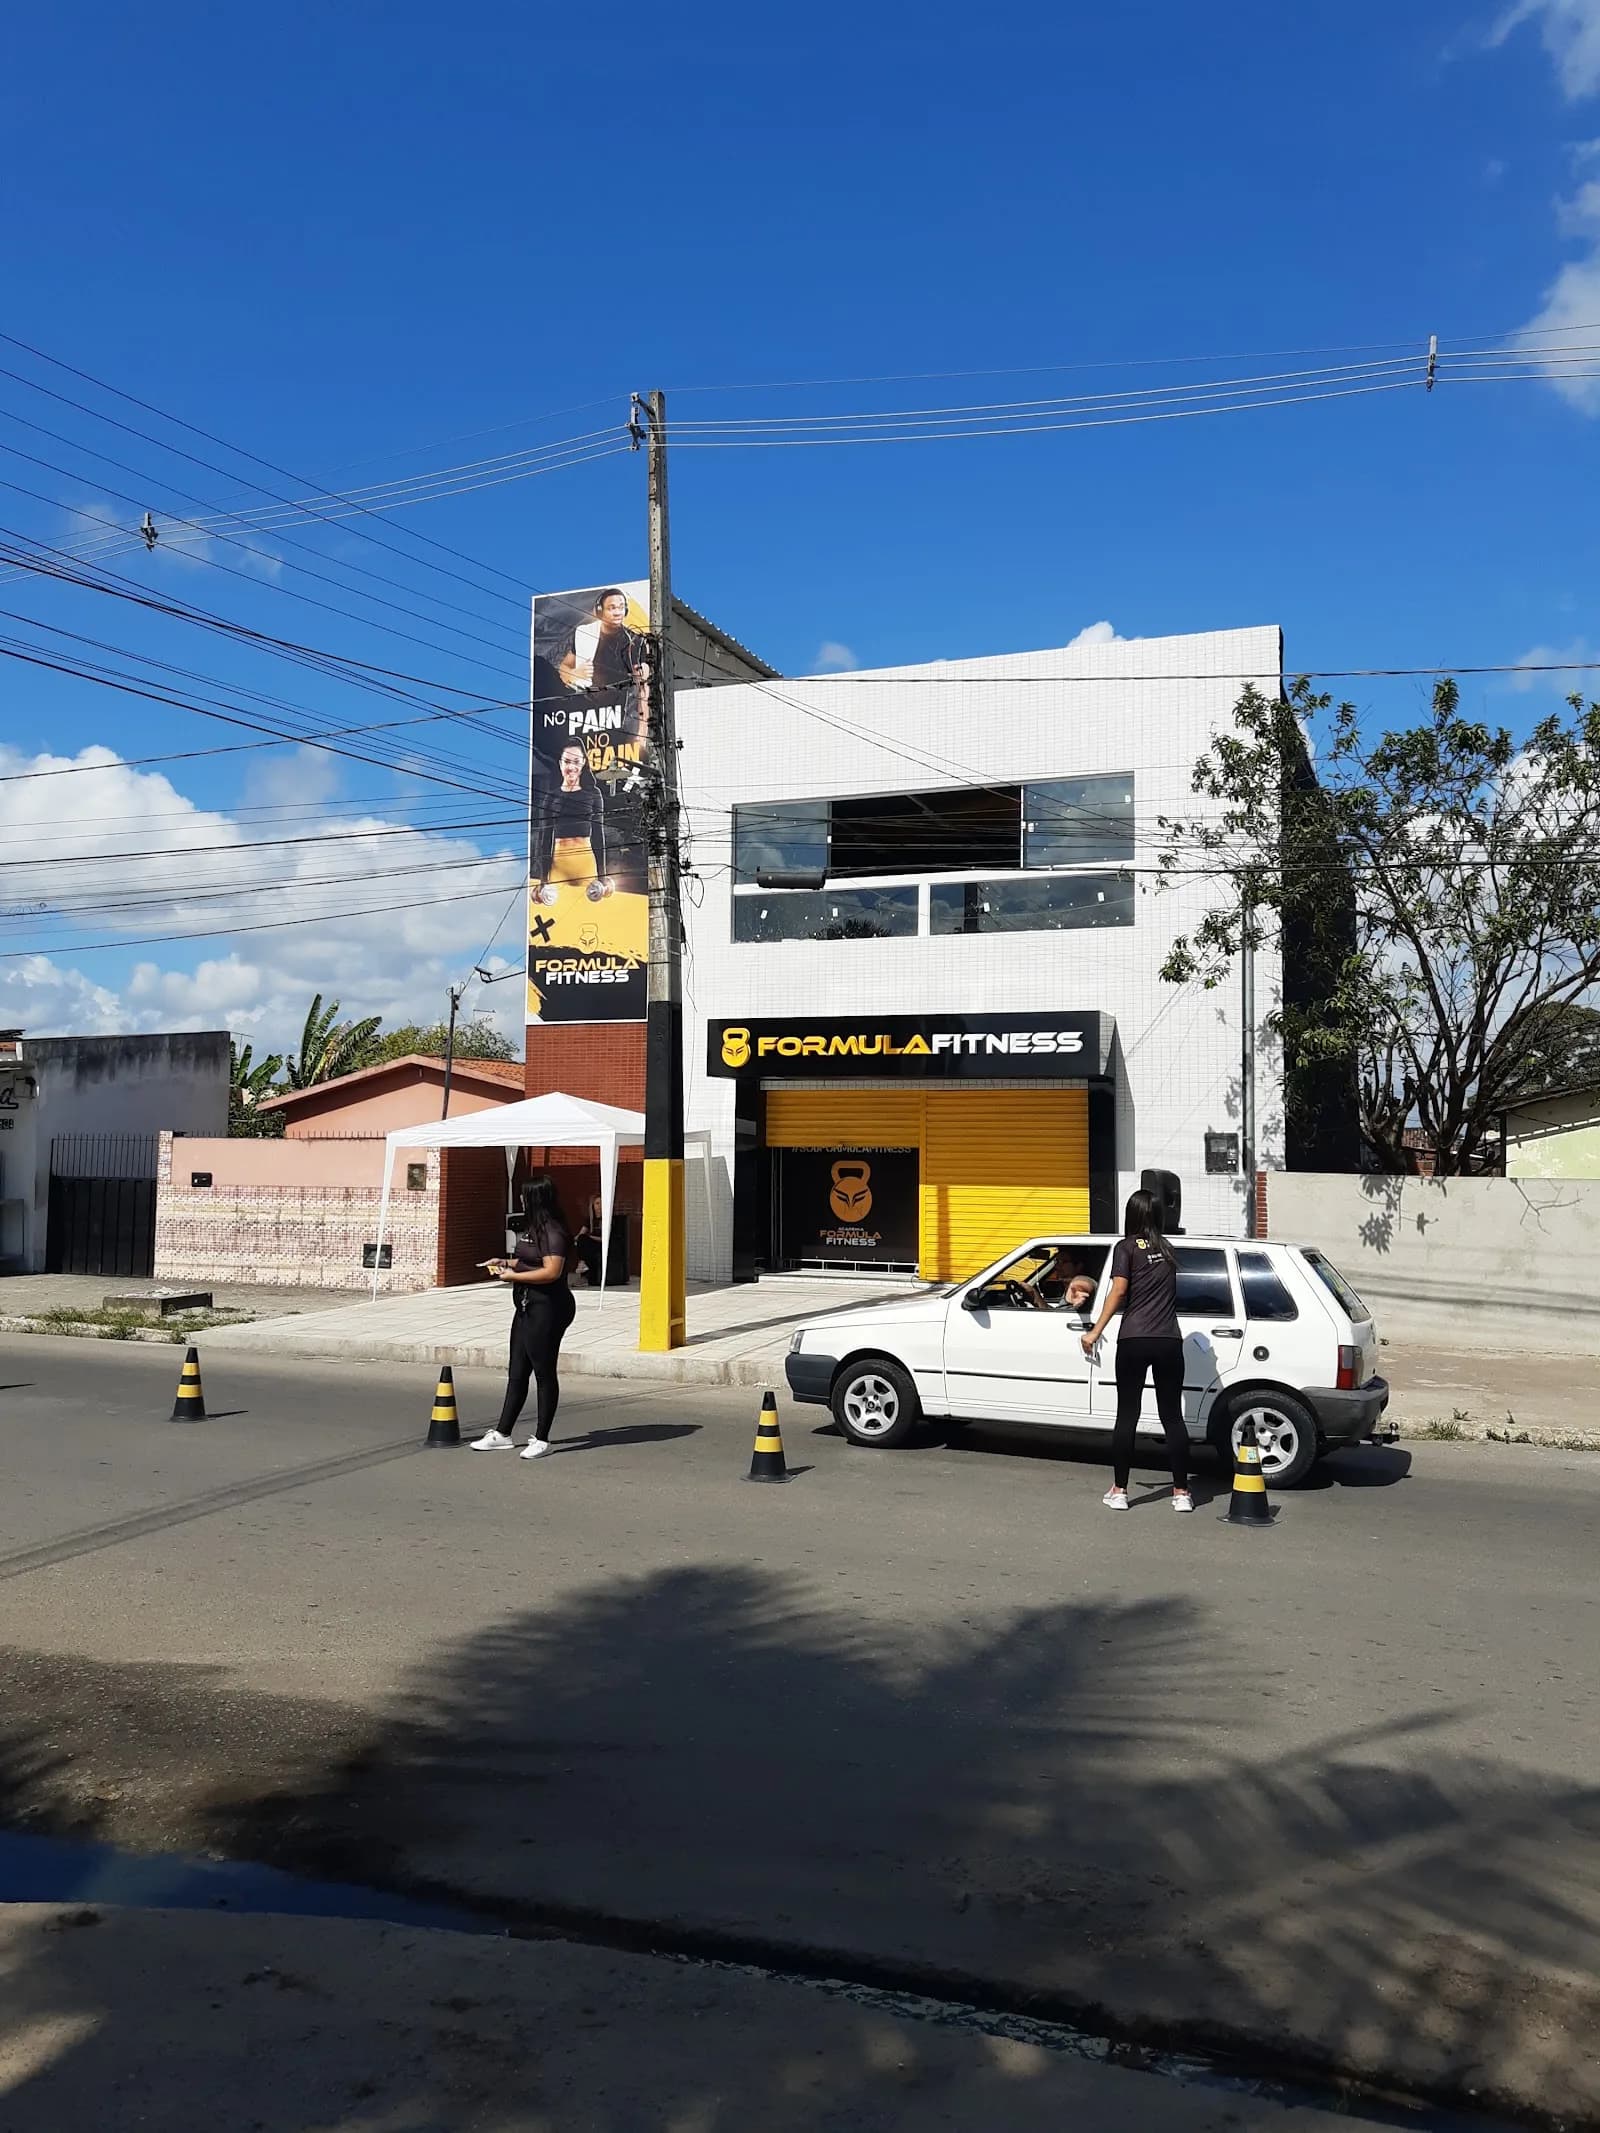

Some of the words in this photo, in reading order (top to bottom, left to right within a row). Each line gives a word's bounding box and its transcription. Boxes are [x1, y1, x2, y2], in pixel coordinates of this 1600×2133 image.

[544, 710, 566, 727] NO
[568, 705, 622, 736] PAIN
[586, 732, 610, 749] NO
[588, 742, 640, 771] GAIN
[535, 957, 640, 973] FORMULA
[545, 969, 629, 985] FITNESS
[819, 1230, 882, 1239] FORMULA
[825, 1237, 877, 1246] FITNESS
